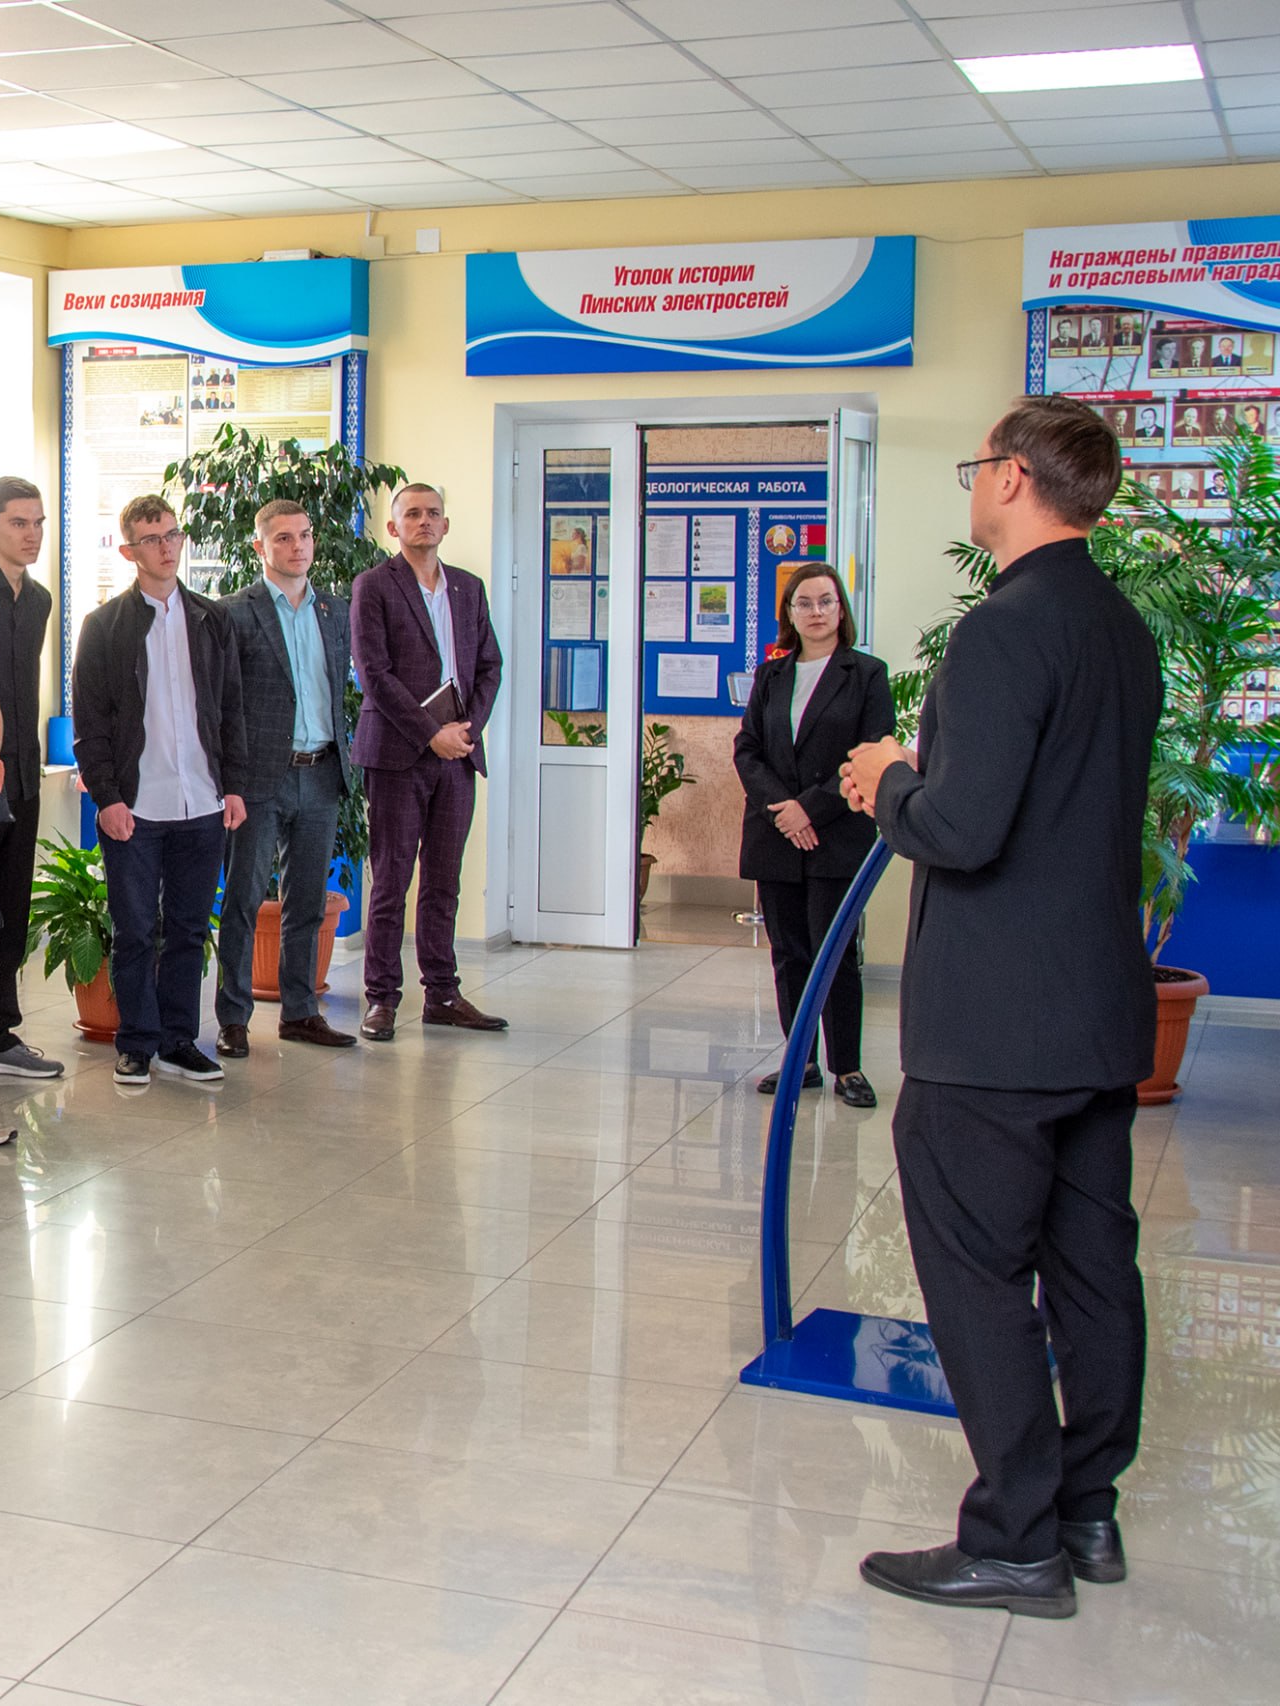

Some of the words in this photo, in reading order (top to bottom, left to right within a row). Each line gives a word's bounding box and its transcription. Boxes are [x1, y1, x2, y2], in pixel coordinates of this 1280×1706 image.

[1049, 248, 1177, 269] Награждены
[1182, 242, 1280, 264] правител
[614, 265, 674, 286] Уголок
[678, 264, 755, 286] истории
[1048, 274, 1062, 288] и
[1067, 267, 1206, 289] отраслевыми
[64, 293, 105, 310] Вехи
[110, 291, 205, 310] созидания
[579, 294, 657, 314] Пинских
[662, 285, 789, 313] электросетей
[646, 482, 749, 495] ДЕОЛОГИЧЕСКАЯ
[757, 481, 807, 493] РАБОТА
